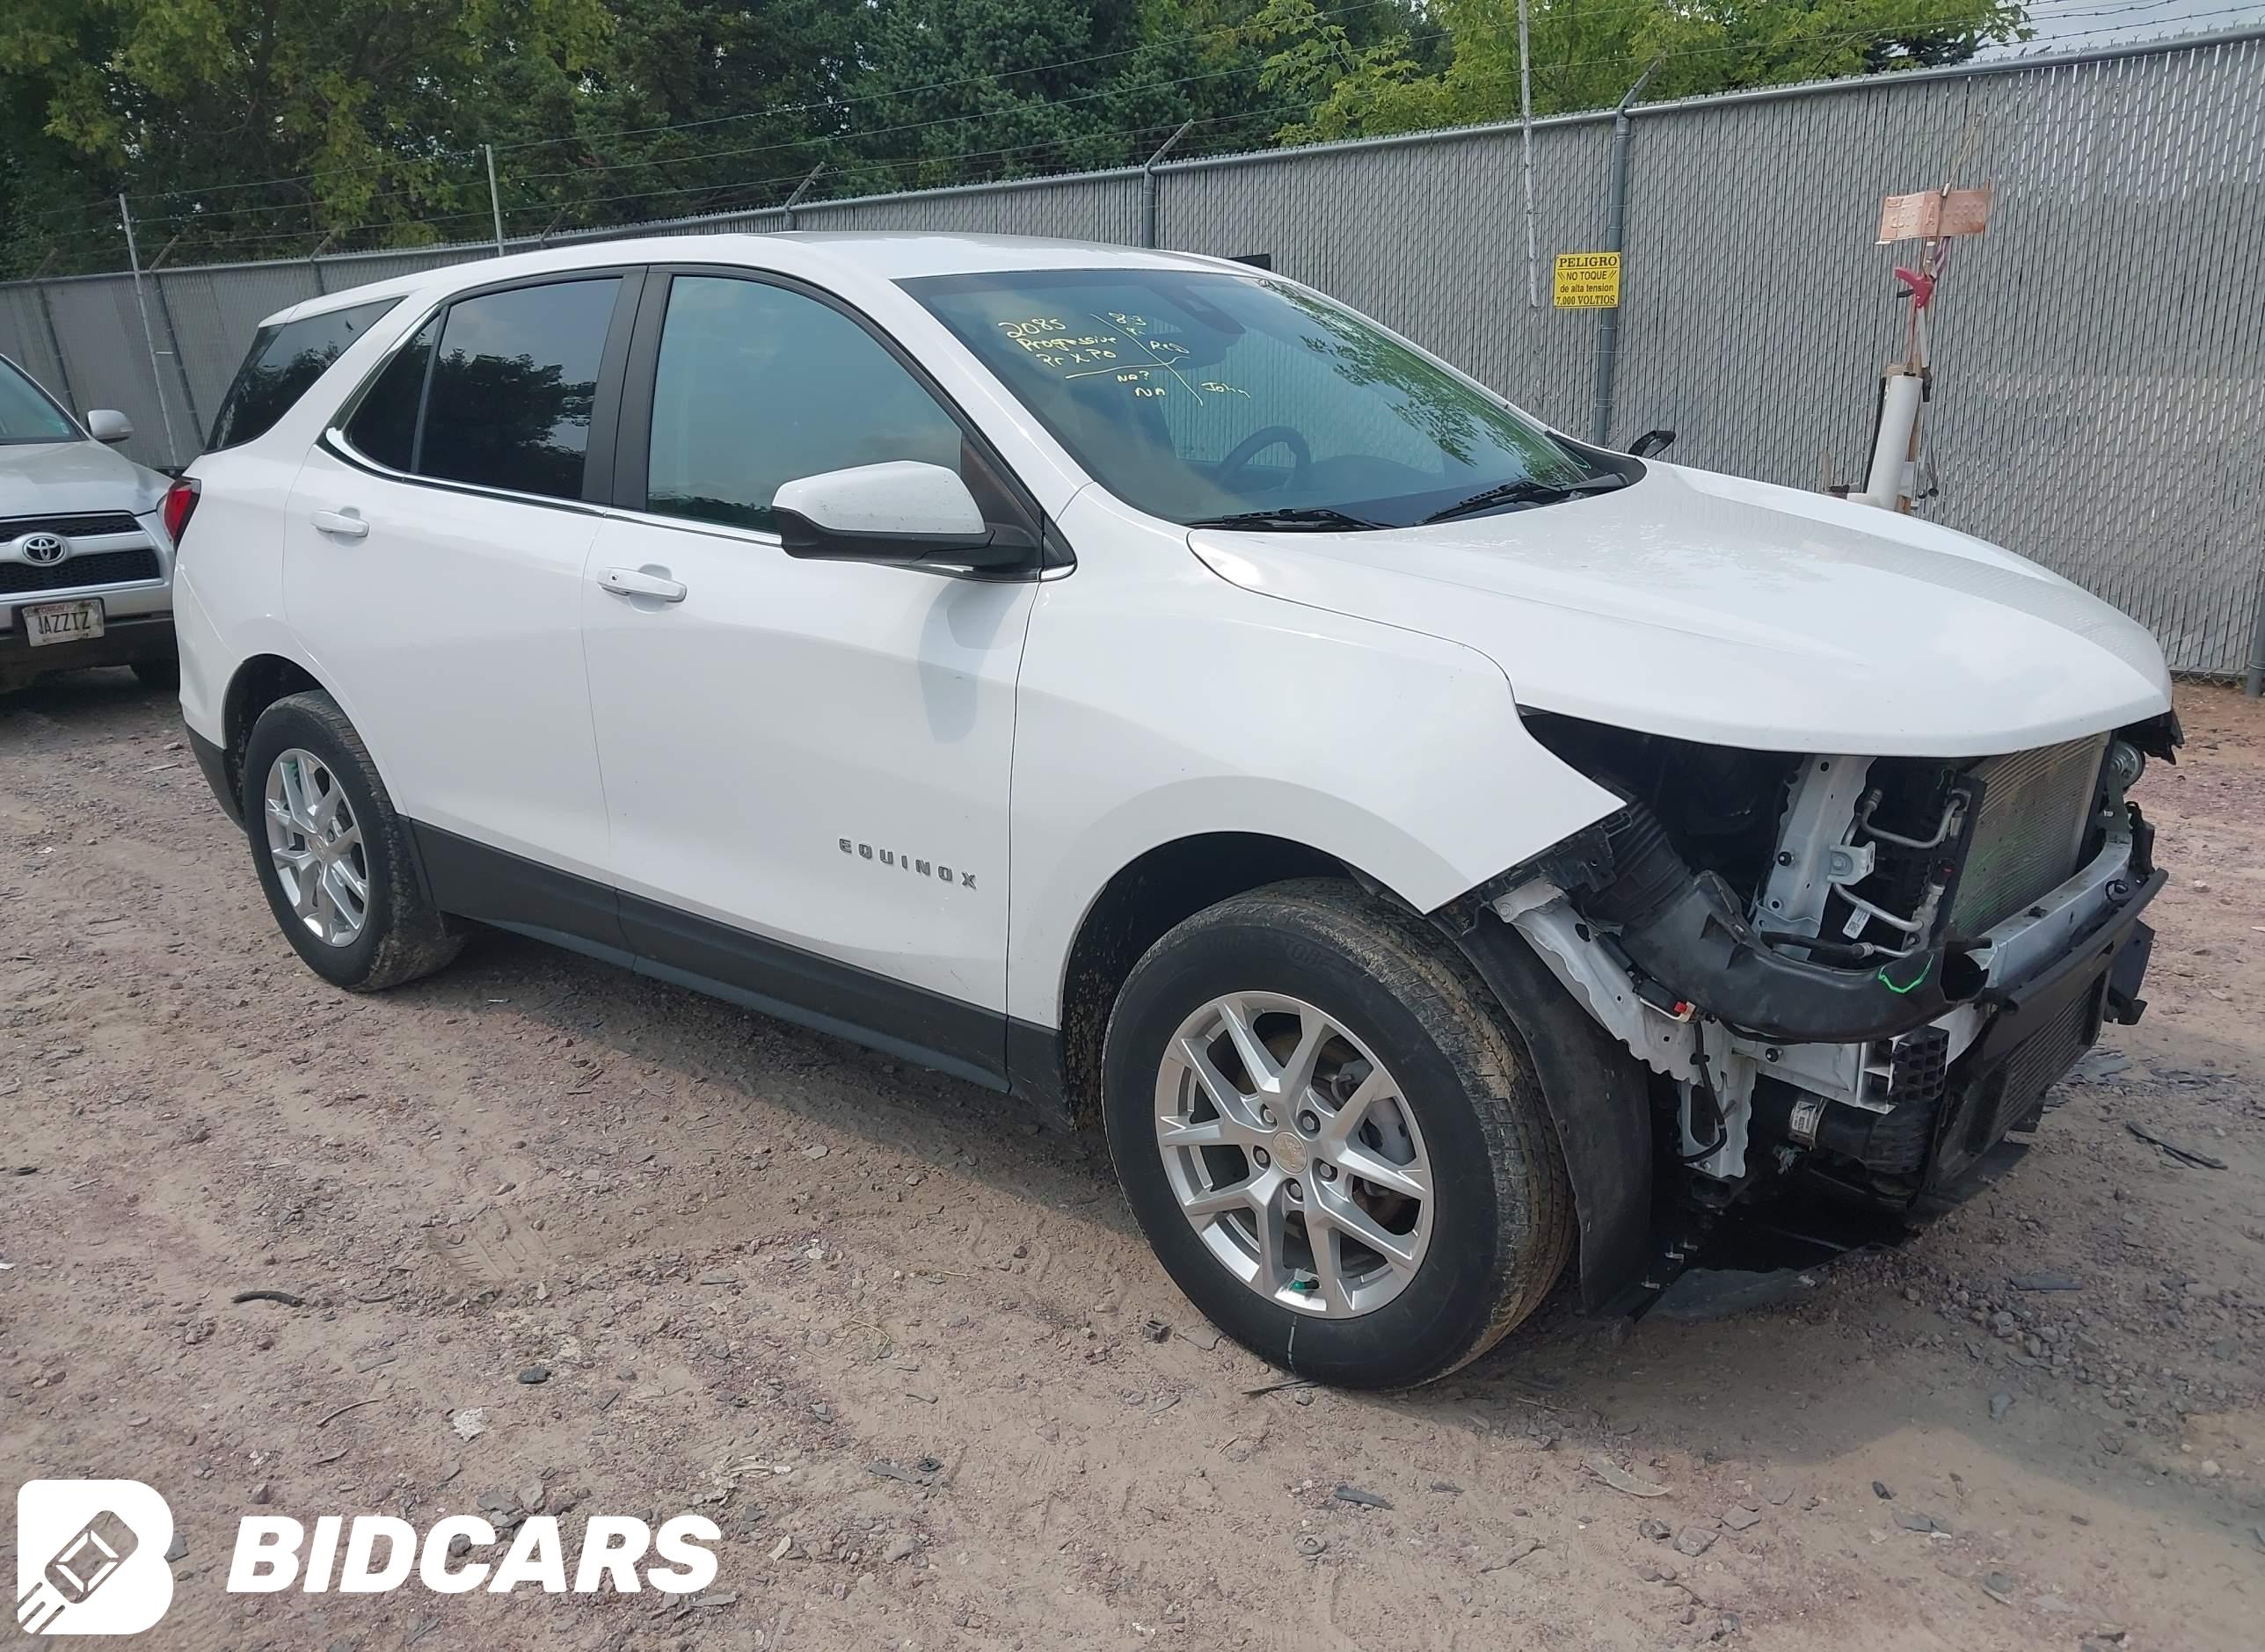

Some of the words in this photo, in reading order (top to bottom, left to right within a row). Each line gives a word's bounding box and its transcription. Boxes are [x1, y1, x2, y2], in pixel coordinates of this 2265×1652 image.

[1559, 256, 1617, 267] PELIGRO
[1566, 271, 1577, 280] NO
[1580, 270, 1607, 280] TOQUE
[1560, 284, 1569, 293] de
[1570, 283, 1584, 293] alta
[1586, 283, 1613, 293] tension
[1577, 295, 1614, 304] VOLTIOS
[997, 317, 1067, 338] 2085
[839, 838, 977, 890] EQUINOX
